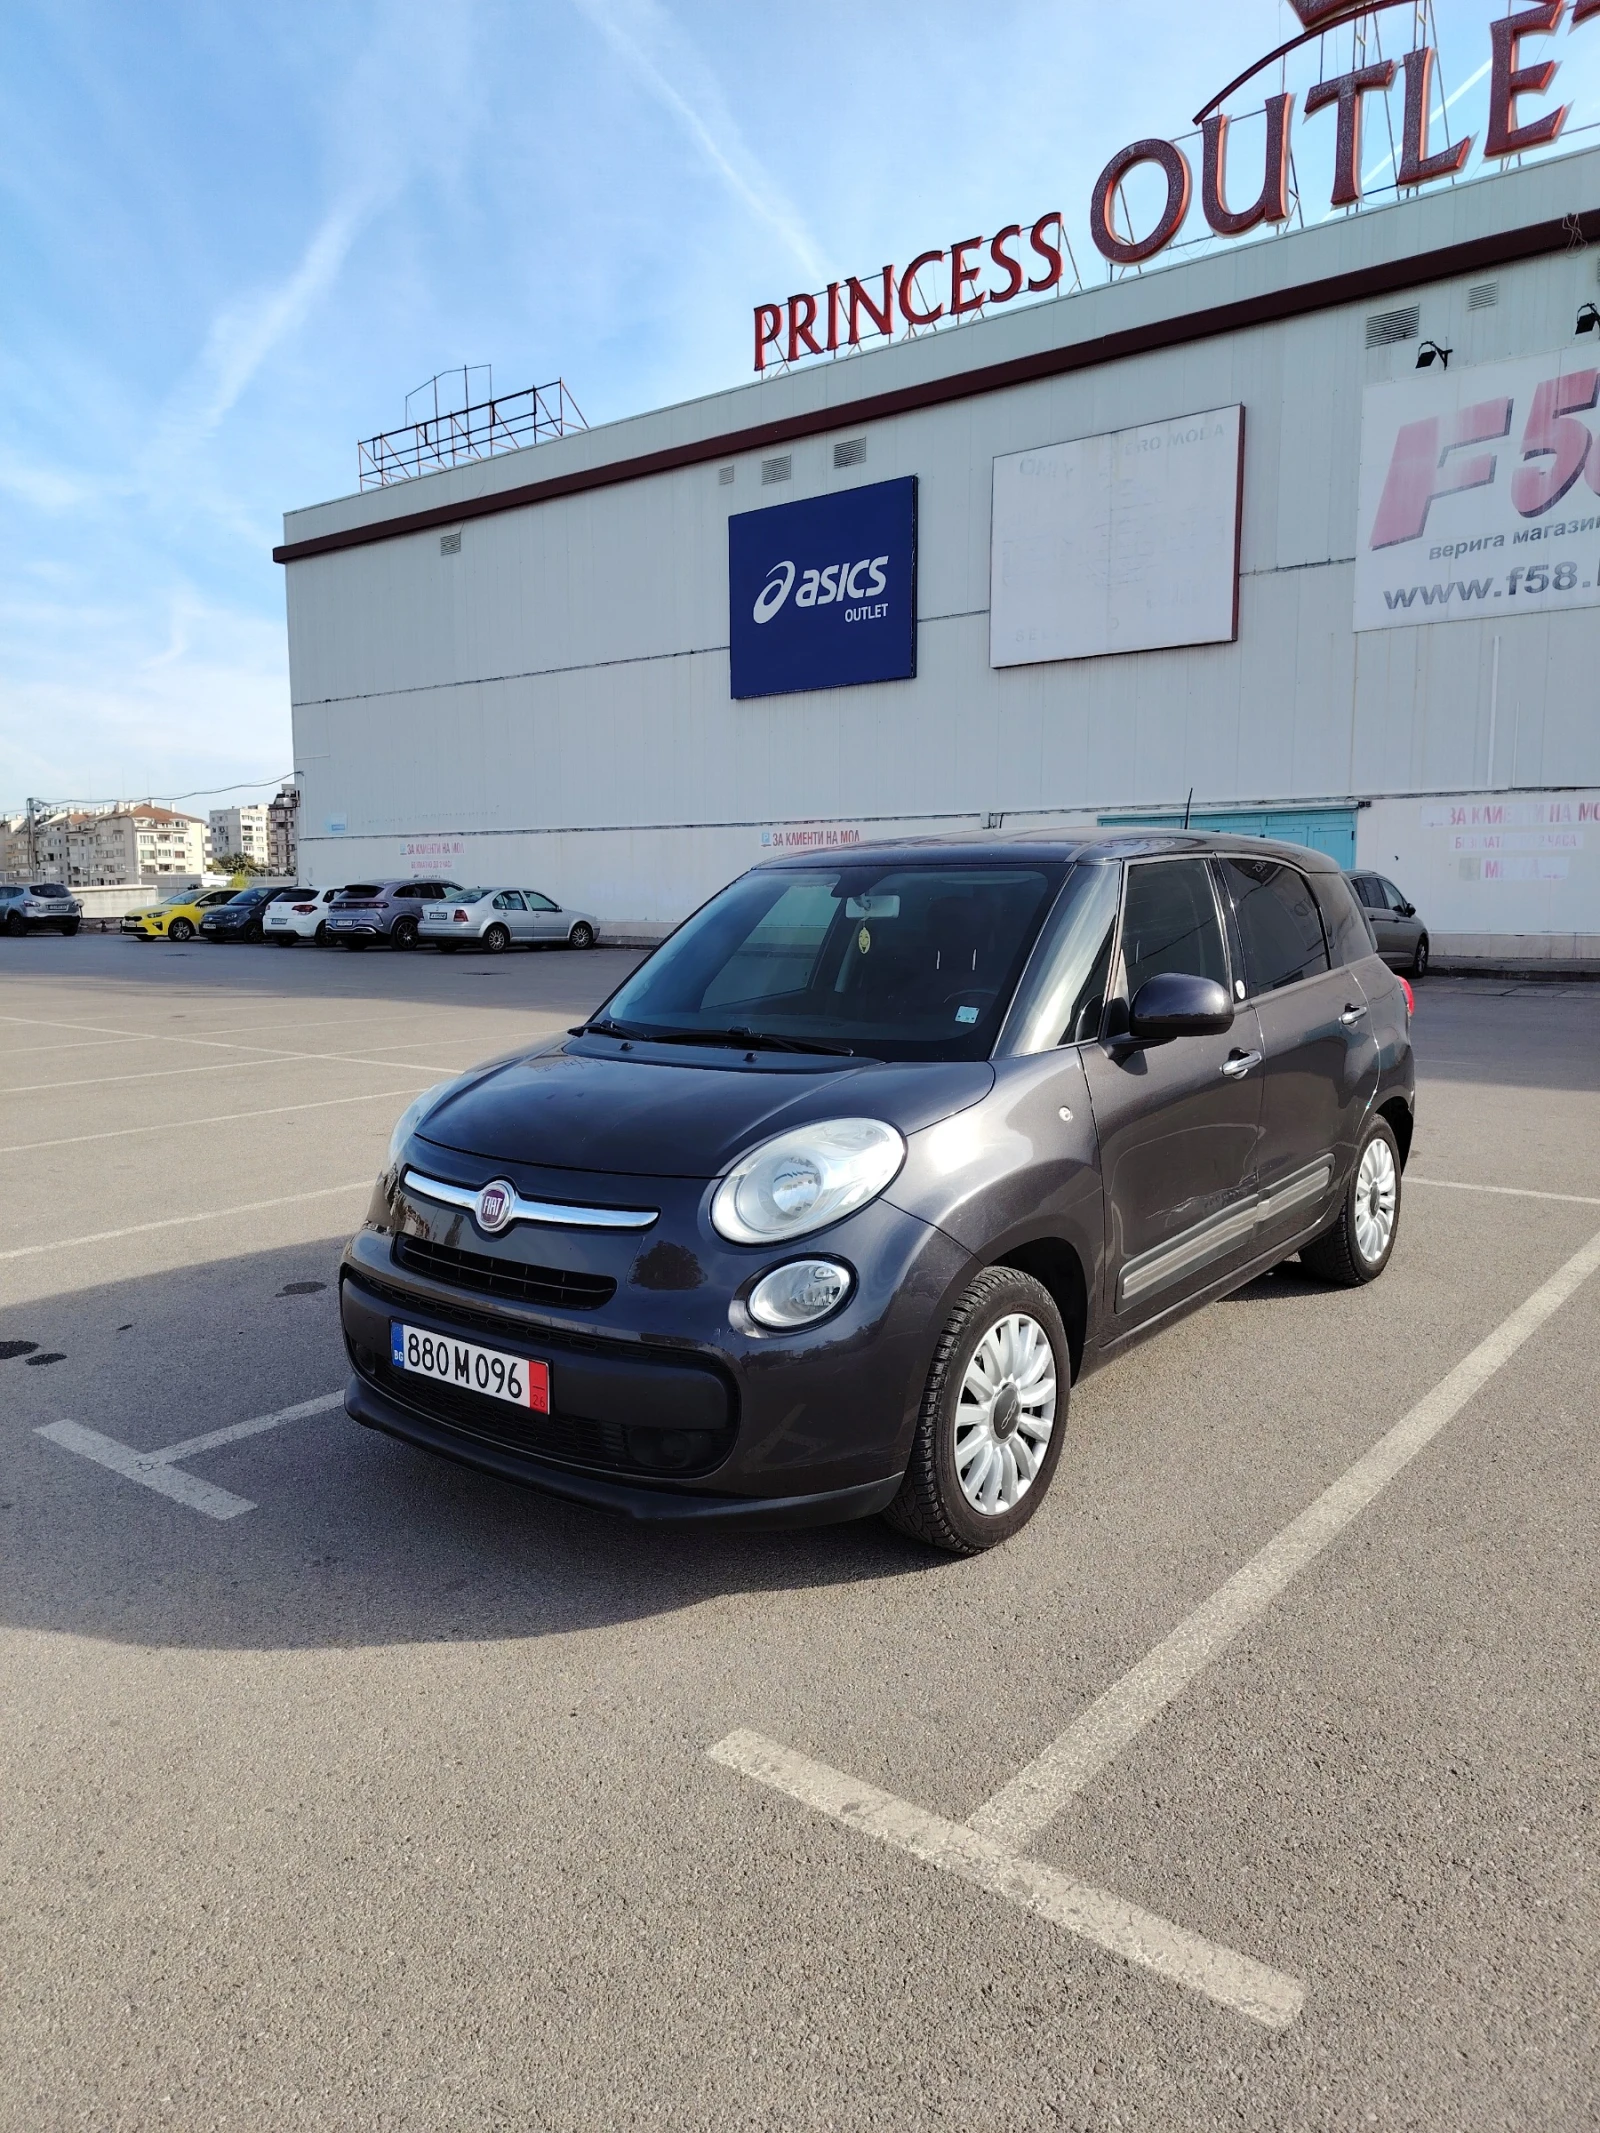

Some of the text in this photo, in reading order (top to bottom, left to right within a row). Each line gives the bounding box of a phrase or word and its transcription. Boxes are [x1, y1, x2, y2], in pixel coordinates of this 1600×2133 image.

[753, 0, 1600, 371] PRINCESS OUTLE
[1368, 366, 1600, 552] F5
[1429, 532, 1504, 560] верига
[1383, 558, 1600, 610] www.f58.
[845, 603, 889, 623] OUTLET
[773, 833, 784, 847] ЗА
[785, 831, 824, 846] КЛИЕНТИ
[827, 830, 838, 844] НА
[483, 1196, 503, 1216] FIAT
[394, 1349, 404, 1362] BG
